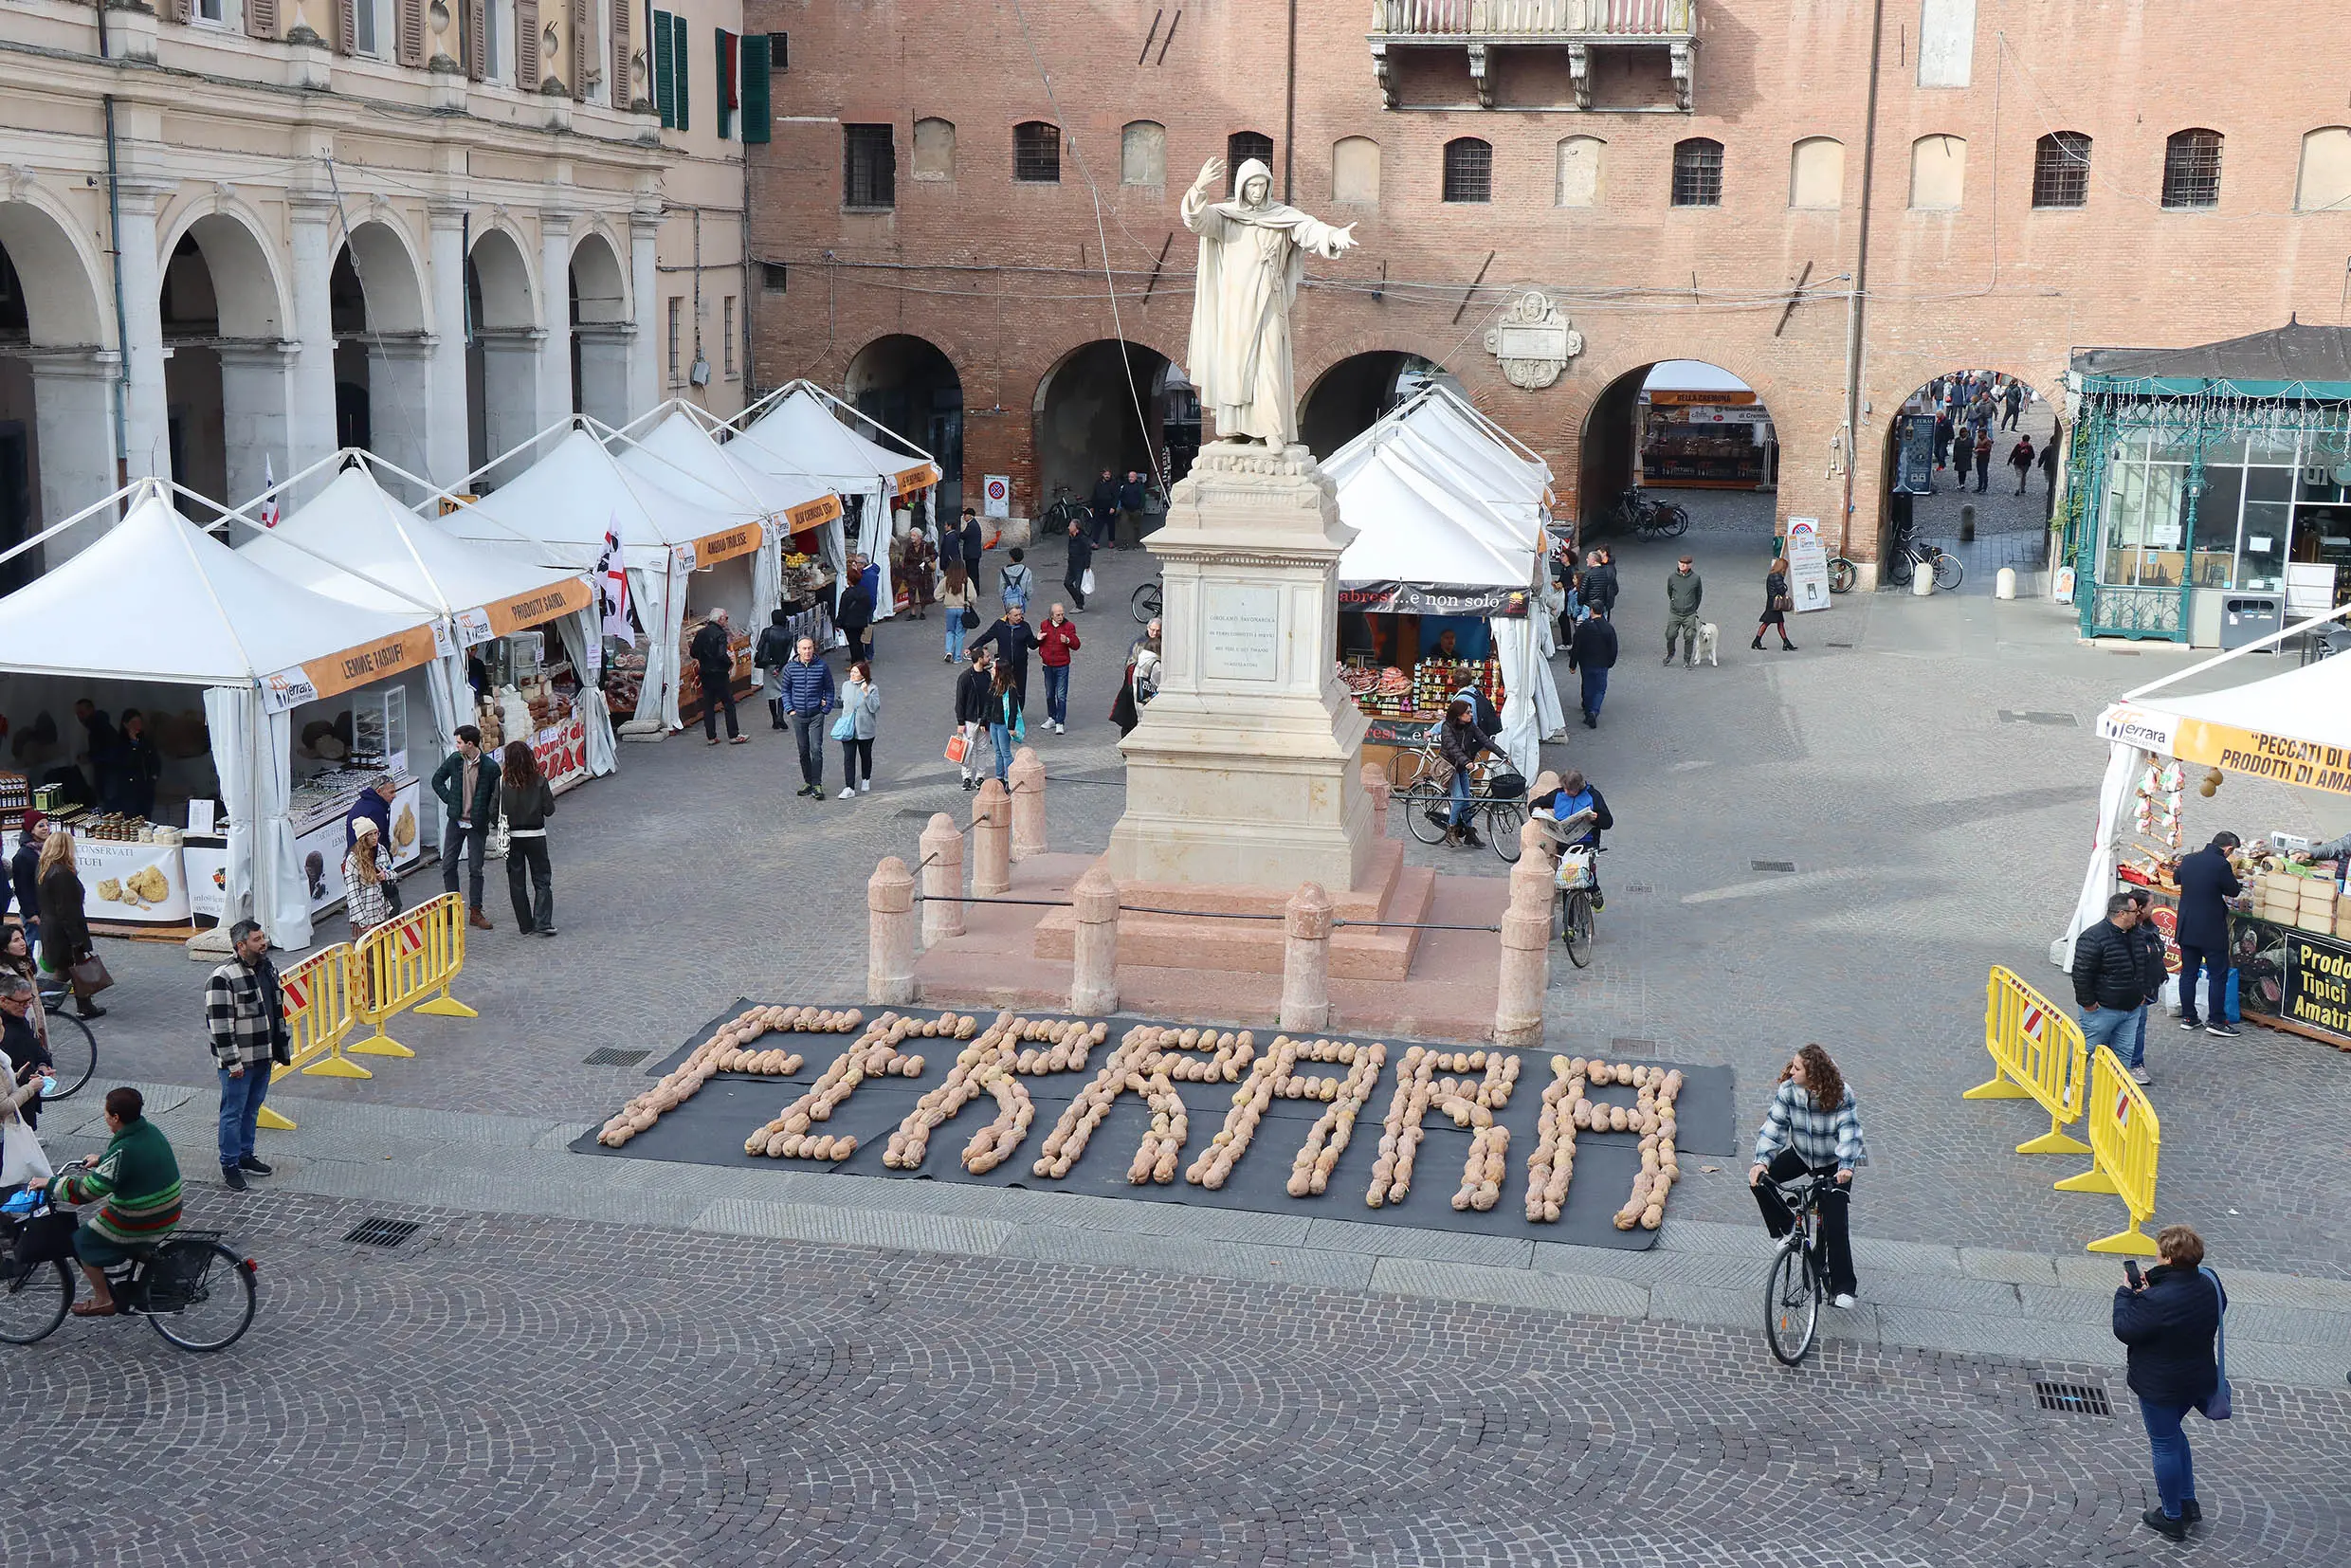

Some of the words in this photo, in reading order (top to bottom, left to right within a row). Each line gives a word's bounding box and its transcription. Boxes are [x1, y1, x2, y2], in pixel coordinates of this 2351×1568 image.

[1677, 393, 1697, 402] BELLA
[1698, 393, 1731, 403] CREMONA
[511, 598, 544, 621] PRODOTTI
[543, 592, 567, 613] SARDI
[1425, 595, 1459, 608] non
[1465, 593, 1500, 608] solo
[340, 653, 374, 680] LEMME
[373, 643, 404, 669] TARTUFI
[2219, 749, 2292, 780] PRODOTTI
[2294, 766, 2313, 785] DI
[2326, 747, 2342, 768] DI
[76, 845, 134, 857] CONSERVATI
[2301, 970, 2346, 1005] Tipici
[597, 1005, 1685, 1231] FERRARA
